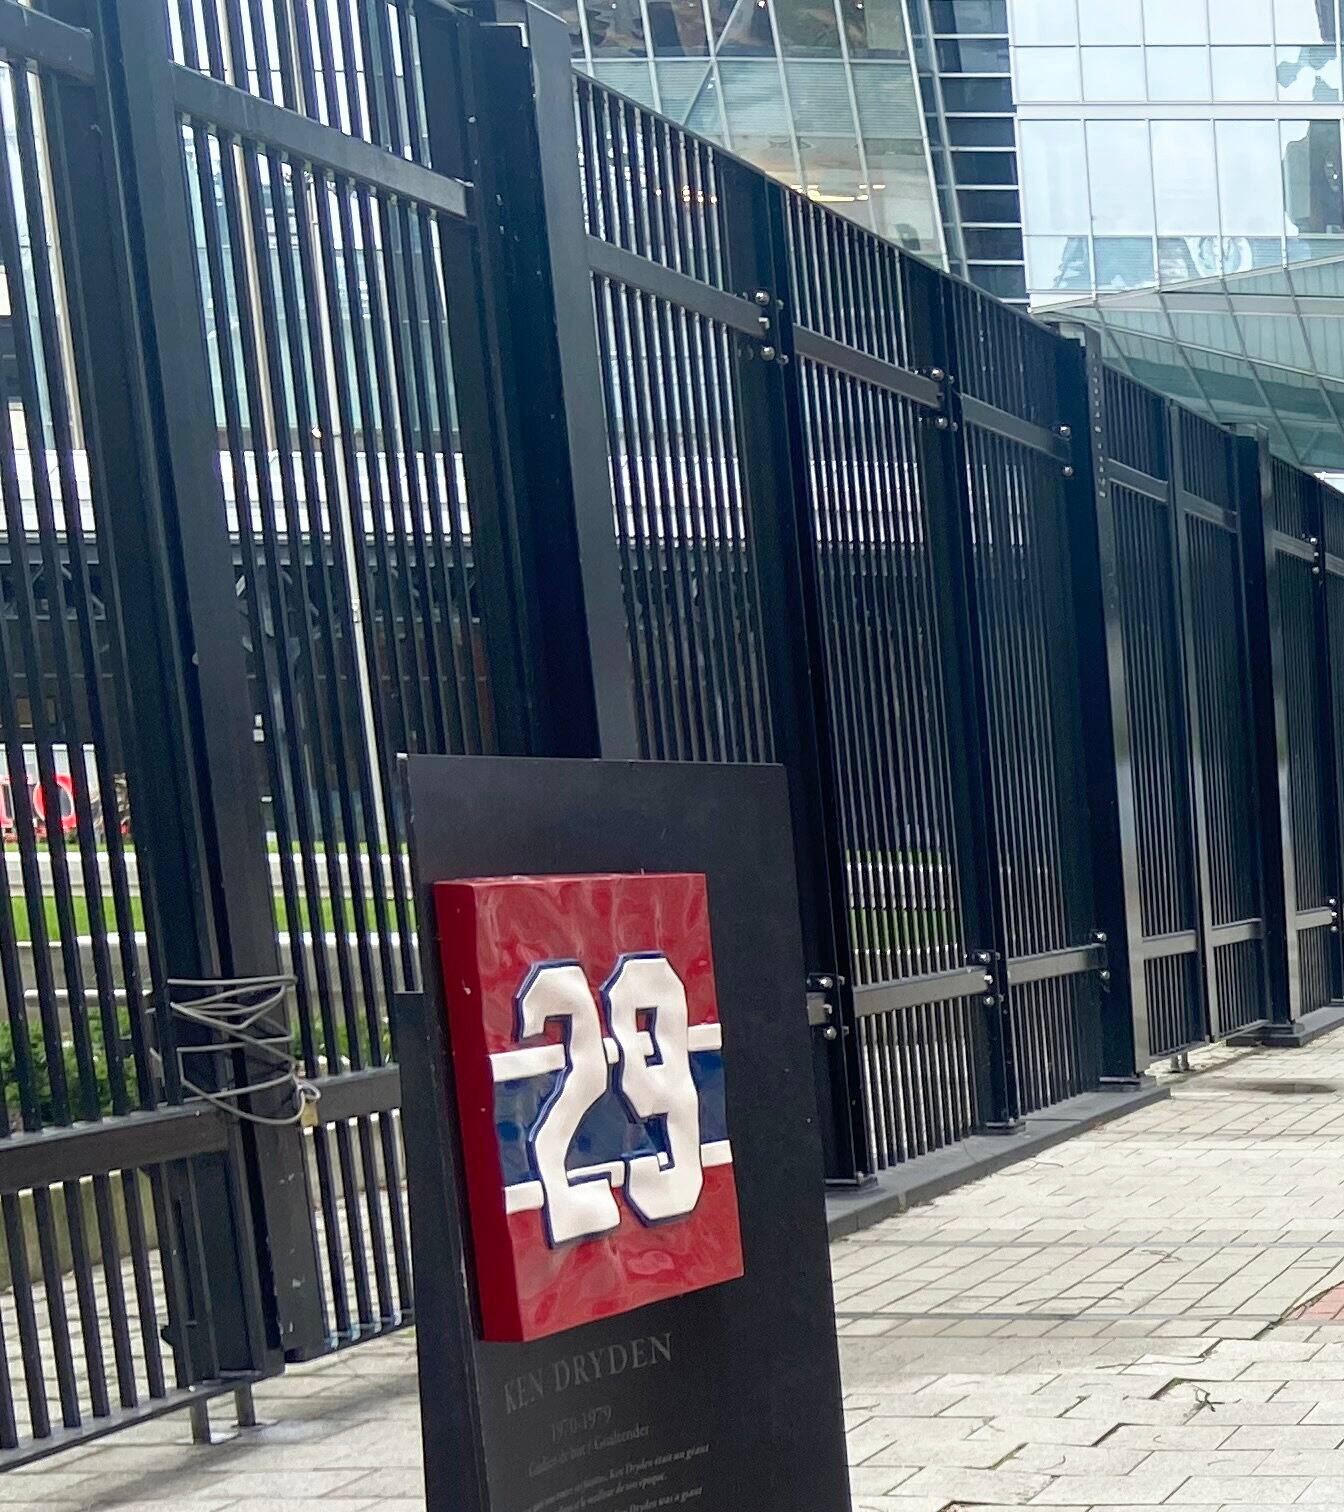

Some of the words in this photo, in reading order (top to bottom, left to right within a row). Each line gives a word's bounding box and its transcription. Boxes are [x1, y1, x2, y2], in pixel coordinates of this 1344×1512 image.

[511, 951, 703, 1248] 29
[503, 1368, 545, 1415] KEN
[552, 1332, 672, 1392] DRYDEN
